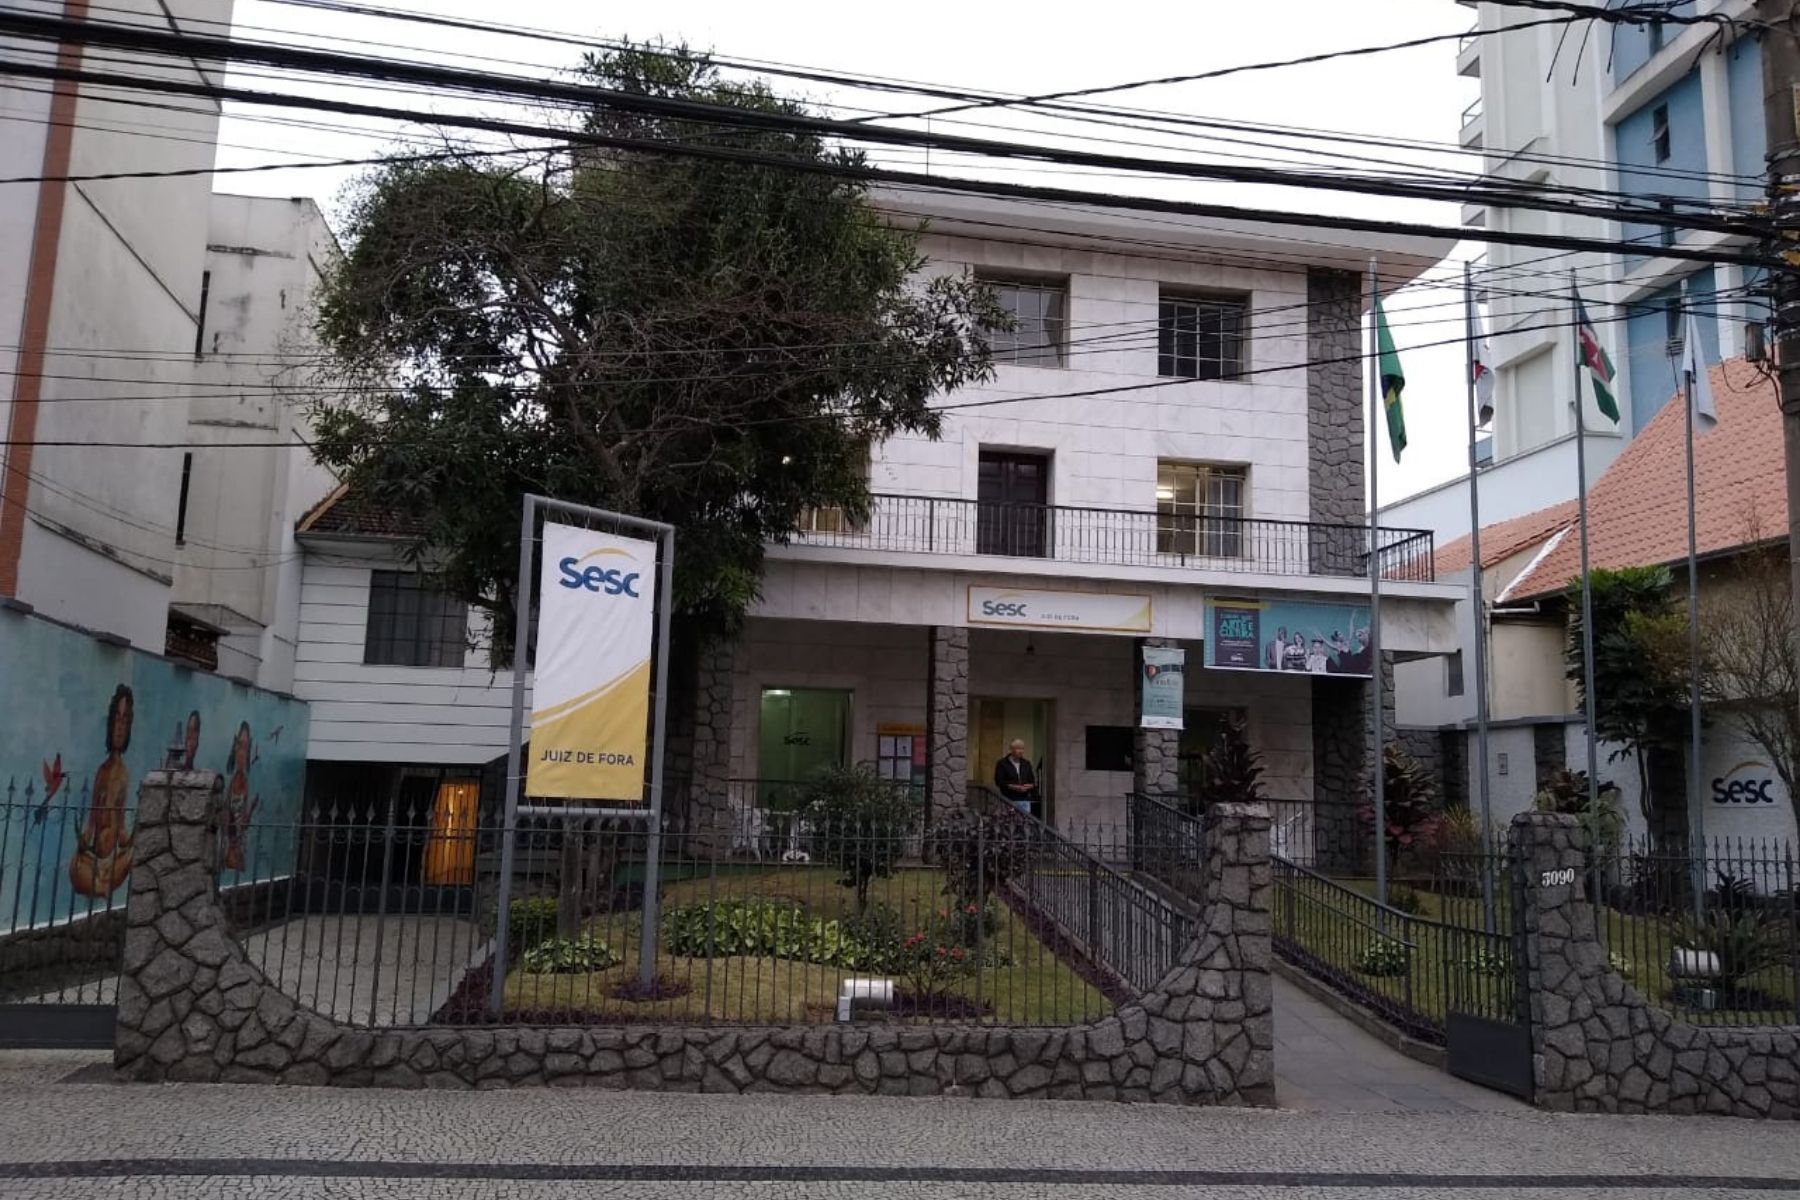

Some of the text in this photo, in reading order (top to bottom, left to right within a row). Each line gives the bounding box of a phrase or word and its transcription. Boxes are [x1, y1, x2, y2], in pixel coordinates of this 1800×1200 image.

[559, 557, 640, 598] Sesc
[982, 600, 1027, 618] Sesc
[541, 749, 634, 766] JUIZ DE FORA
[1711, 777, 1774, 804] Sesc
